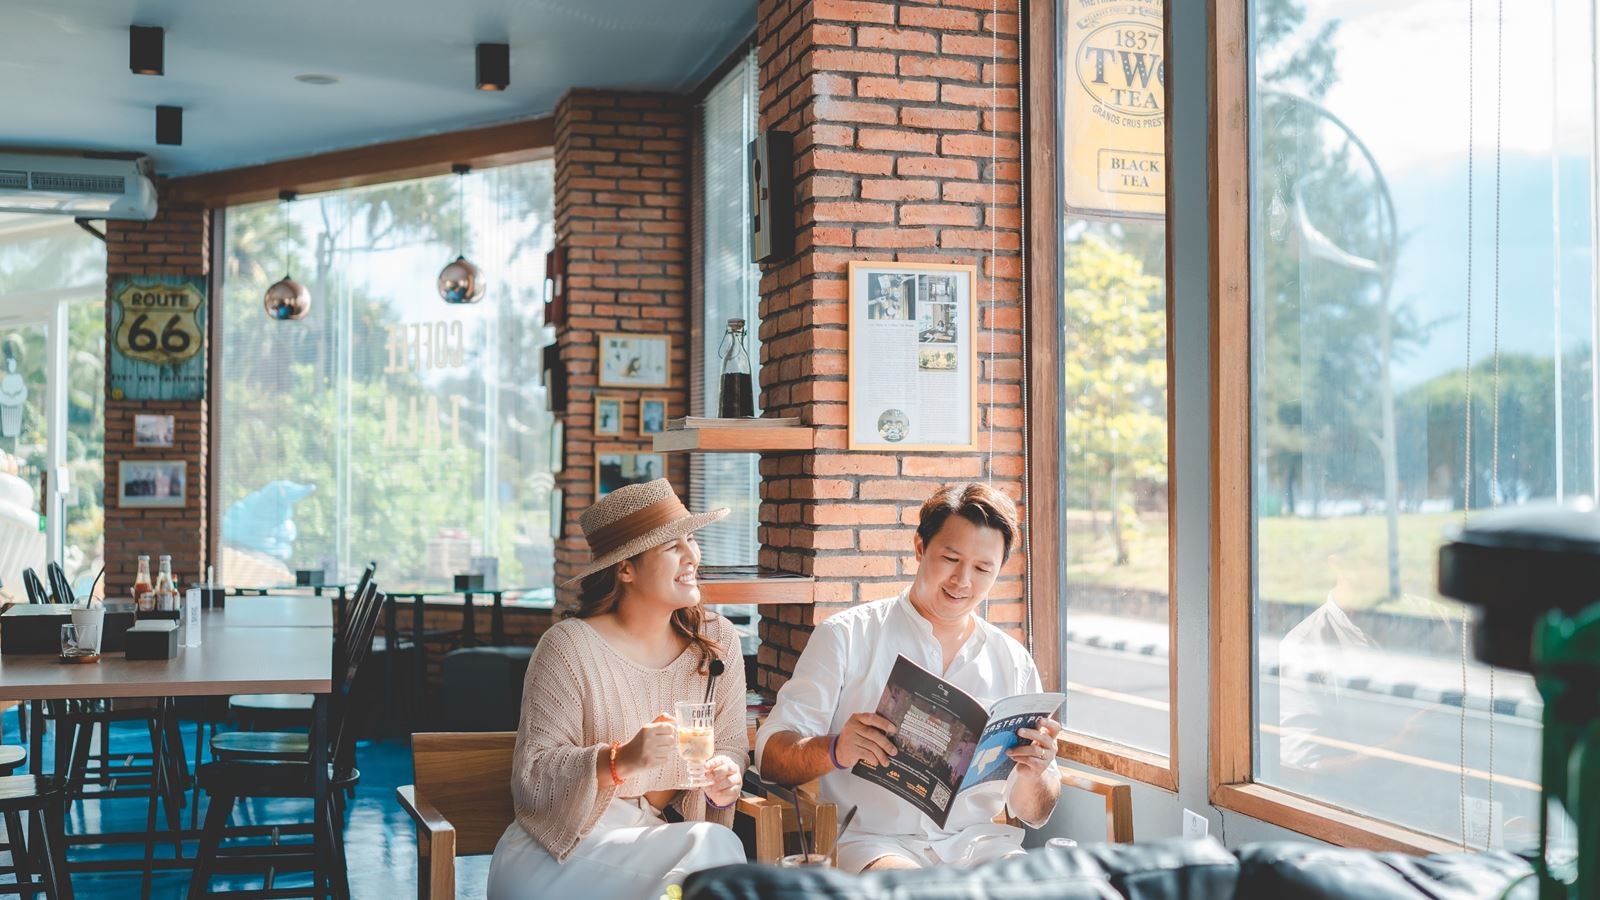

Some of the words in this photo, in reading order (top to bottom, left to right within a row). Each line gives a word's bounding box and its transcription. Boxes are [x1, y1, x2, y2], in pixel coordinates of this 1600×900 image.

[1115, 30, 1159, 51] 1837
[1110, 88, 1159, 109] TEA
[1092, 104, 1120, 125] GRANDS
[1111, 157, 1160, 172] BLACK
[1121, 173, 1149, 188] TEA
[131, 292, 189, 308] ROUTE
[127, 313, 191, 353] 66
